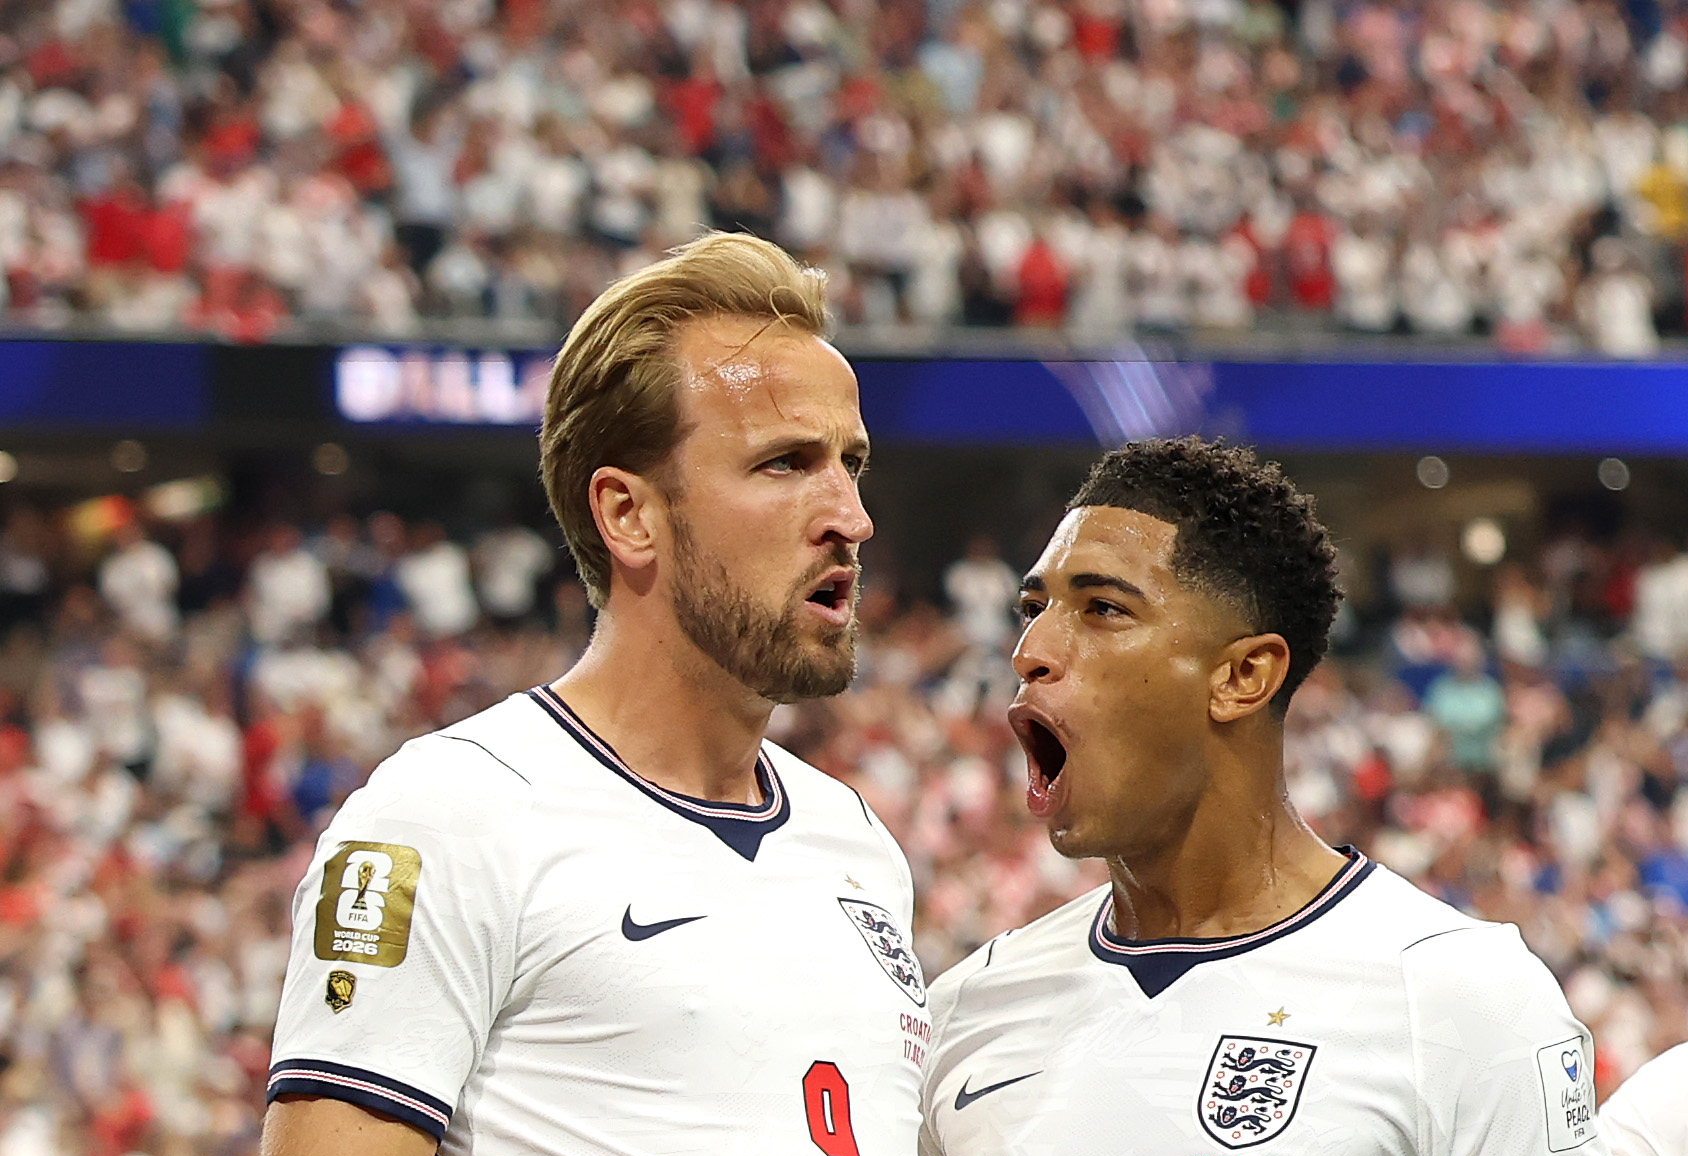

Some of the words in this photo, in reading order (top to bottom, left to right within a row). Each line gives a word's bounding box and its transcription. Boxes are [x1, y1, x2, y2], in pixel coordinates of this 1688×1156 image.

[348, 912, 368, 922] FIFA
[334, 930, 361, 940] WORLD
[361, 933, 380, 942] CUP
[332, 939, 378, 956] 2026
